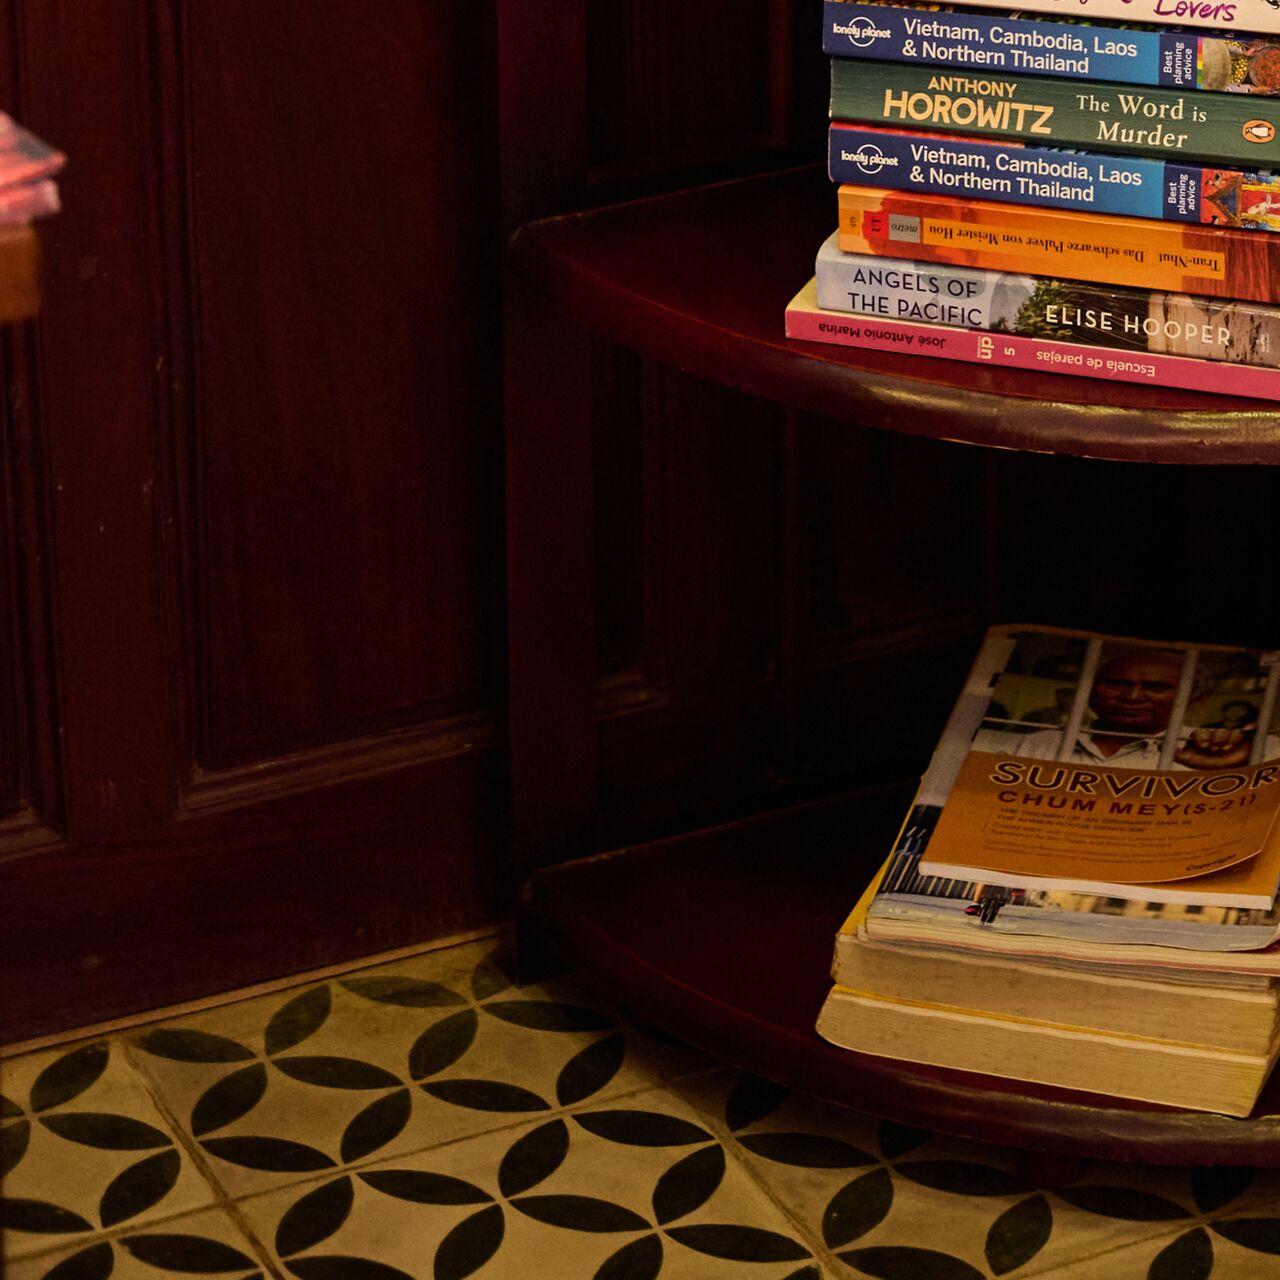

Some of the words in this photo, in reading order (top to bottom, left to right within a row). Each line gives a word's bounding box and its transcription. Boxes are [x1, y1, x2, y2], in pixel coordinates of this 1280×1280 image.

[833, 21, 862, 38] lonely
[862, 23, 892, 40] planet
[904, 16, 985, 43] Vietnam,
[989, 24, 1089, 53] Cambodia,
[1093, 36, 1138, 57] Laos
[901, 40, 918, 57] &
[923, 42, 1006, 65] Northern
[1010, 49, 1090, 74] Thailand
[927, 75, 1017, 99] ANTHONY
[882, 88, 1055, 135] HOROWITZ
[1076, 94, 1111, 114] The
[1118, 94, 1184, 121] Word
[1192, 105, 1208, 123] is
[1097, 121, 1188, 149] Murder
[852, 267, 939, 295] ANGELS
[945, 278, 977, 298] OF
[848, 292, 891, 314] THE
[897, 298, 983, 326] PACIFIC
[1046, 304, 1114, 331] ELISE
[1124, 316, 1231, 346] HOOPER
[1036, 348, 1083, 367] parejas
[1087, 353, 1103, 369] de
[1109, 356, 1157, 376] Escuela
[996, 789, 1097, 813] CHUM
